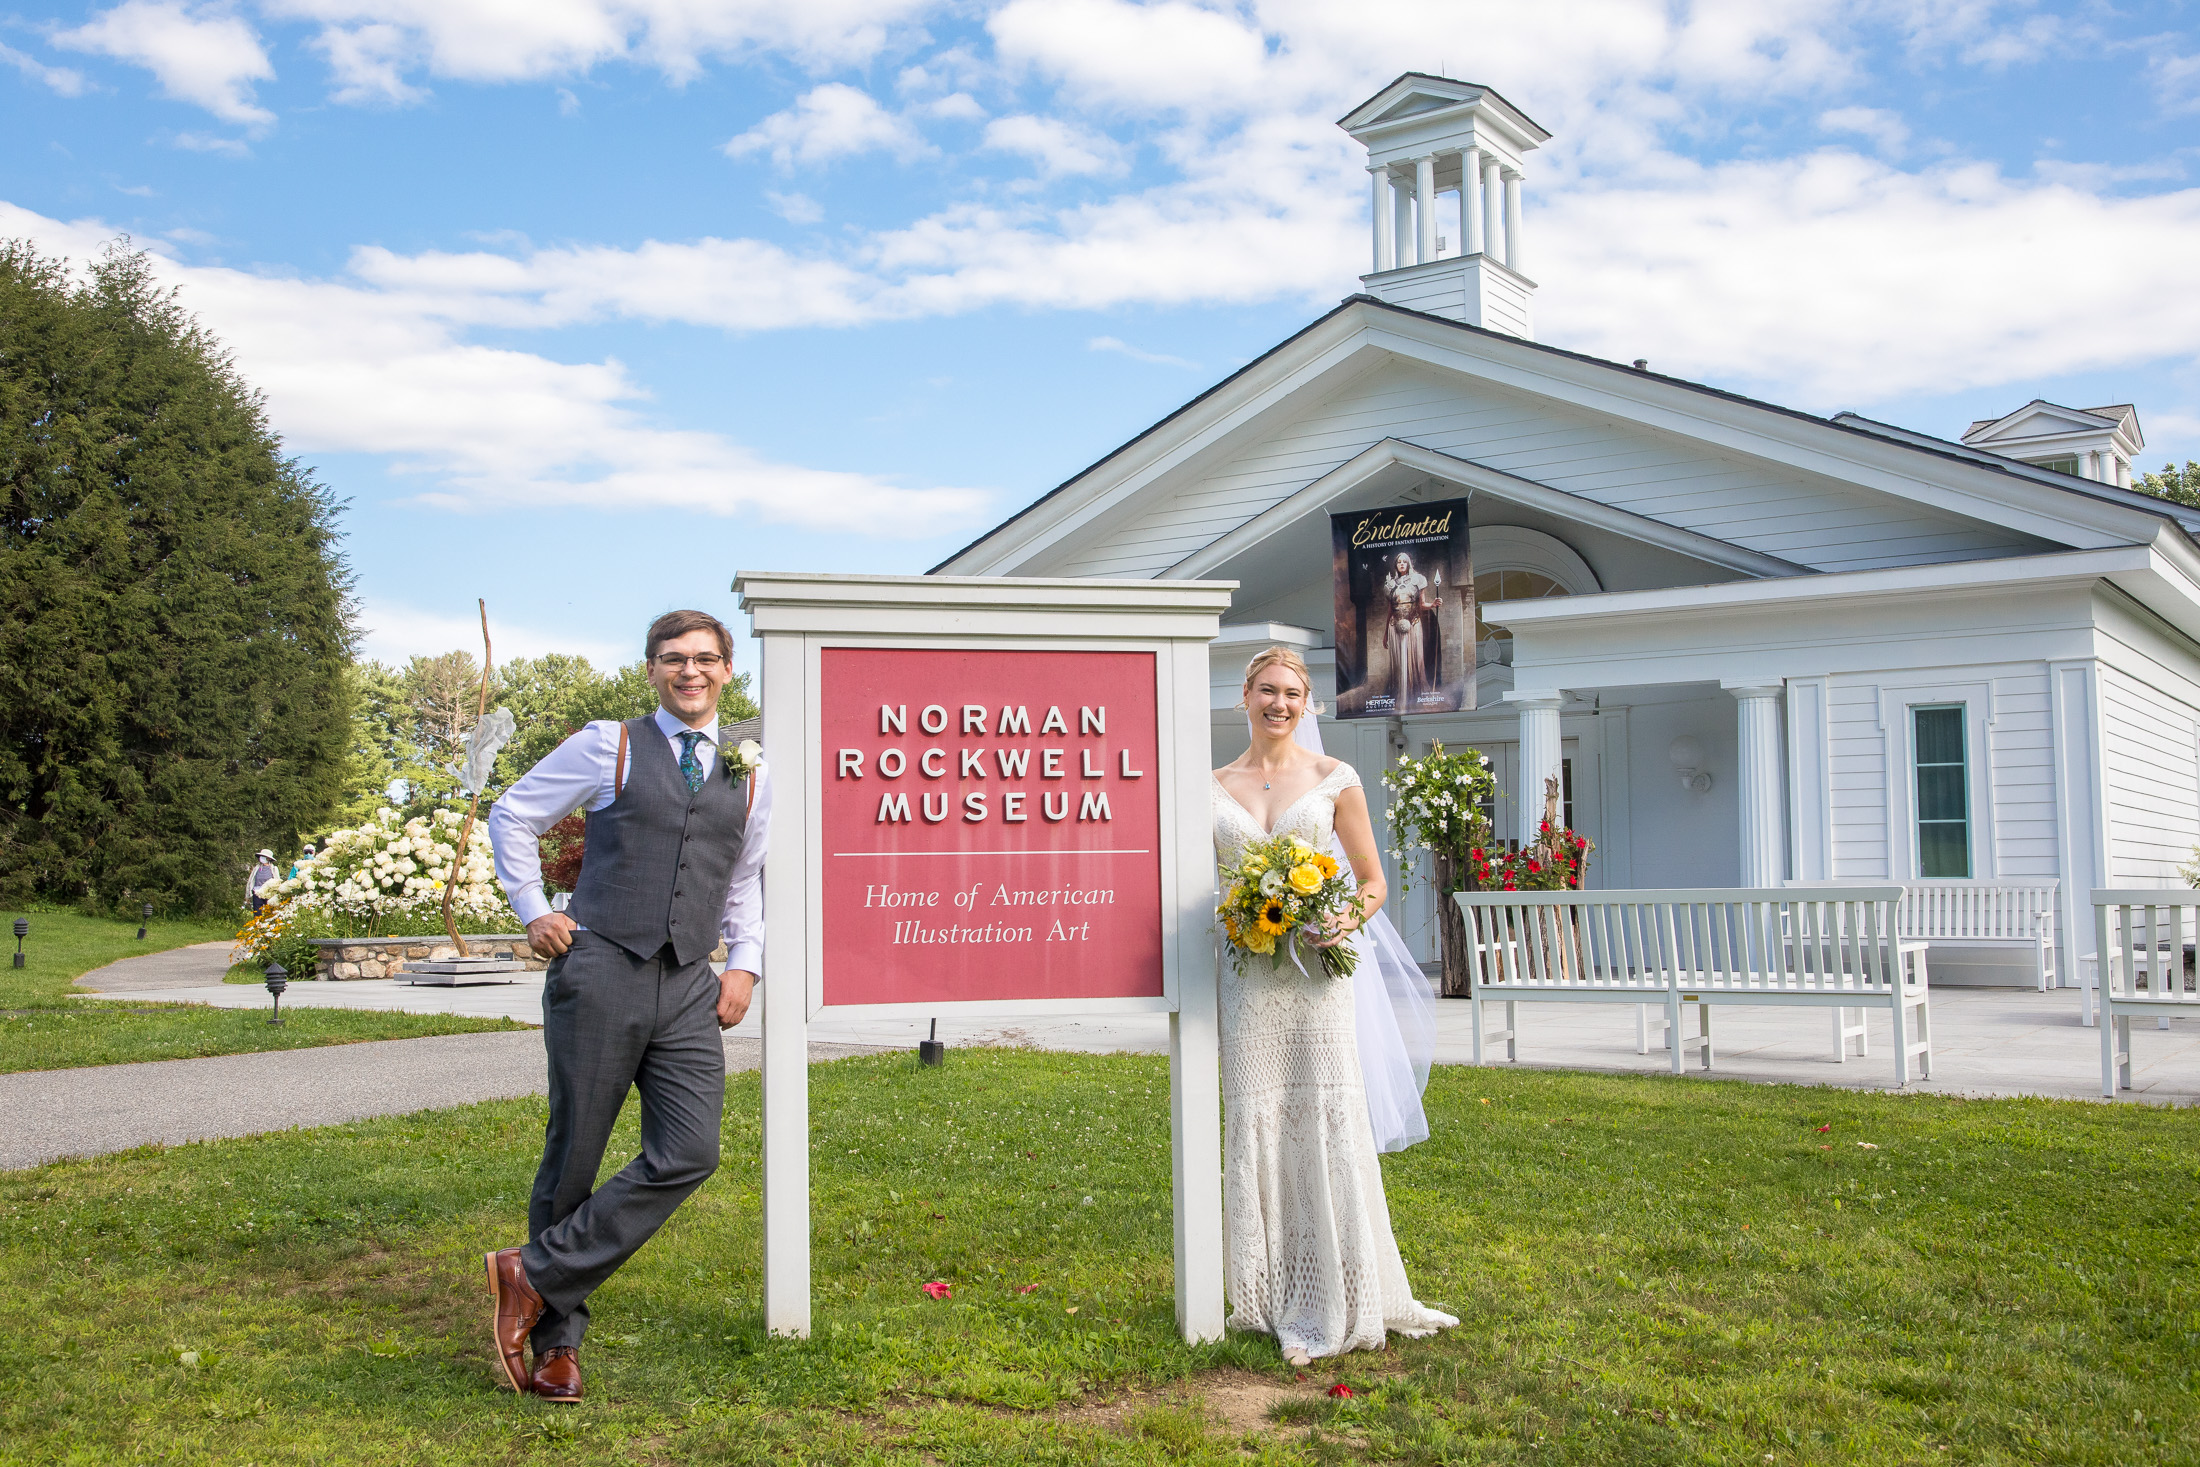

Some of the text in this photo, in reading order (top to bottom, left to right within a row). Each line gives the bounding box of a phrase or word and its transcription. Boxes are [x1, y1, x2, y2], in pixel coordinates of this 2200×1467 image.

[1352, 510, 1452, 550] Enchanted
[1415, 535, 1449, 543] ILLUSTRATION
[1365, 698, 1396, 706] HERITAGE
[880, 704, 1106, 734] NORMAN
[838, 747, 1144, 778] ROCKWELL
[876, 791, 1113, 822] MUSEUM
[864, 883, 1115, 912] Home of American
[893, 919, 1090, 944] Illustration Art
